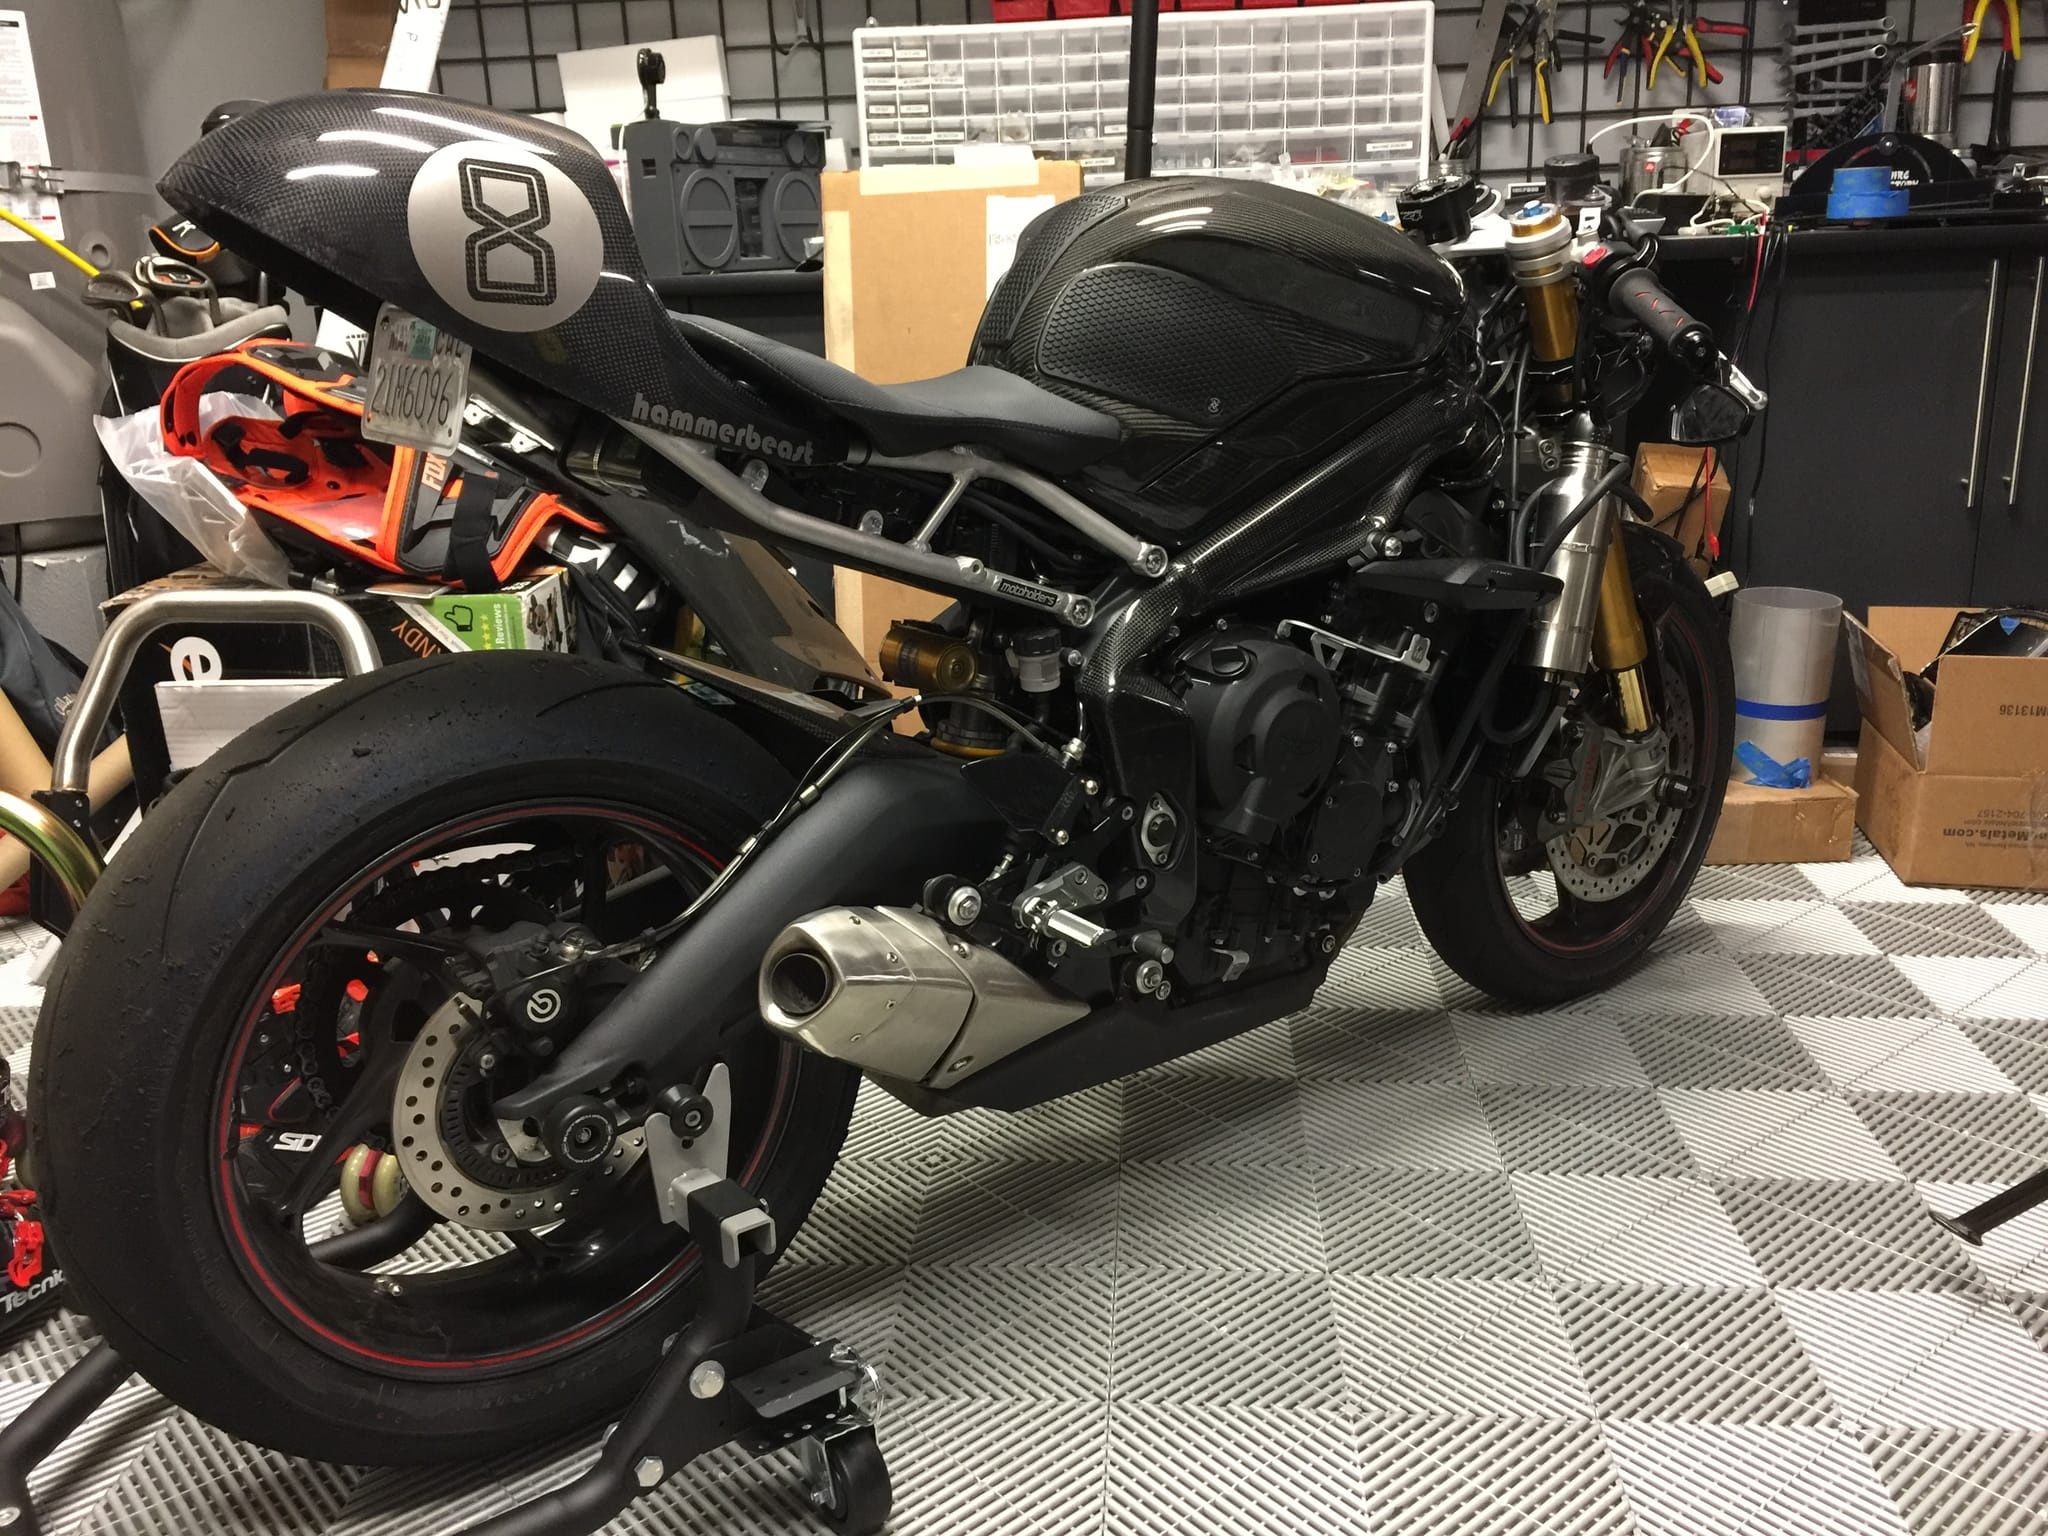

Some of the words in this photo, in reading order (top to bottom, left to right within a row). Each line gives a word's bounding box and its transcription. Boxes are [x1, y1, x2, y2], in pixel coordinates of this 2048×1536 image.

[458, 158, 557, 306] 8
[632, 392, 815, 466] hammerbeast
[391, 619, 441, 659] NDY
[494, 603, 505, 646] Reviews
